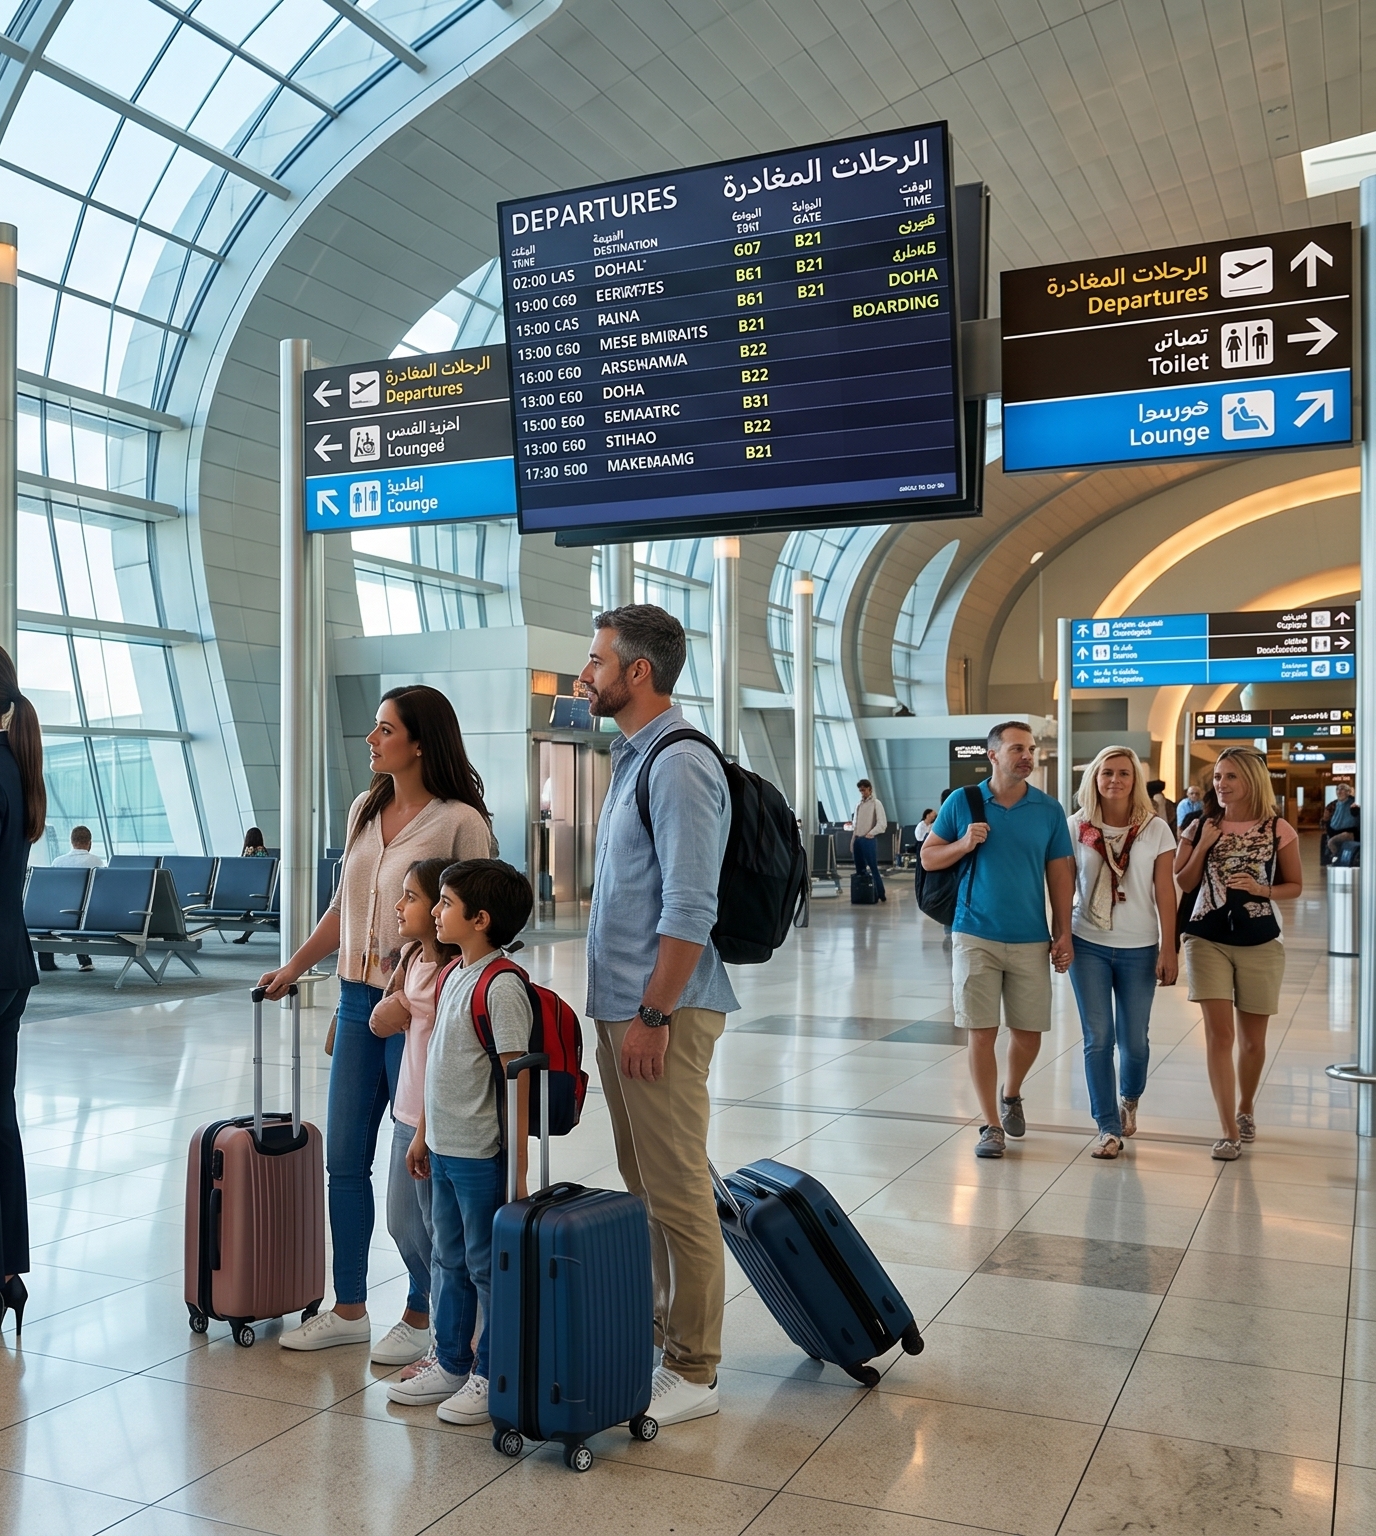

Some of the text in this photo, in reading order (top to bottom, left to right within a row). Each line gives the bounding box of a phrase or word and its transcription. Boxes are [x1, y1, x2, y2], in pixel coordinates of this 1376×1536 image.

[723, 138, 929, 202] الرحلات المغادرة
[511, 185, 678, 236] DEPARTURES
[793, 212, 822, 225] GATE
[903, 194, 932, 207] TIME
[513, 274, 547, 290] 02:00
[551, 269, 576, 284] LAS
[794, 231, 822, 248] B21
[593, 238, 658, 257] DESTINATION
[515, 297, 548, 313] 19:00
[796, 257, 823, 273] B21
[737, 292, 763, 307] B61
[797, 283, 824, 299] B21
[888, 267, 939, 287] DOHA
[1046, 256, 1208, 298] الرحلات المغادرة
[1088, 284, 1209, 315] Departures
[518, 345, 552, 361] 13:00
[600, 334, 637, 351] MESE
[738, 317, 765, 333] B21
[852, 294, 939, 318] BOARDING
[385, 355, 490, 386] الرحلات المغادرة
[519, 370, 553, 385] 16:00
[740, 343, 767, 358] B22
[1148, 352, 1209, 376] Toilet
[386, 382, 463, 404] Departures
[520, 368, 769, 408] 13:00 E60 DOHA B22
[522, 417, 557, 433] 15:00
[742, 394, 769, 409] B31
[524, 441, 558, 456] 13:00
[605, 431, 657, 448] STIHAO
[744, 419, 771, 434] B22
[745, 444, 772, 459] B21
[1130, 425, 1210, 446] Lounge
